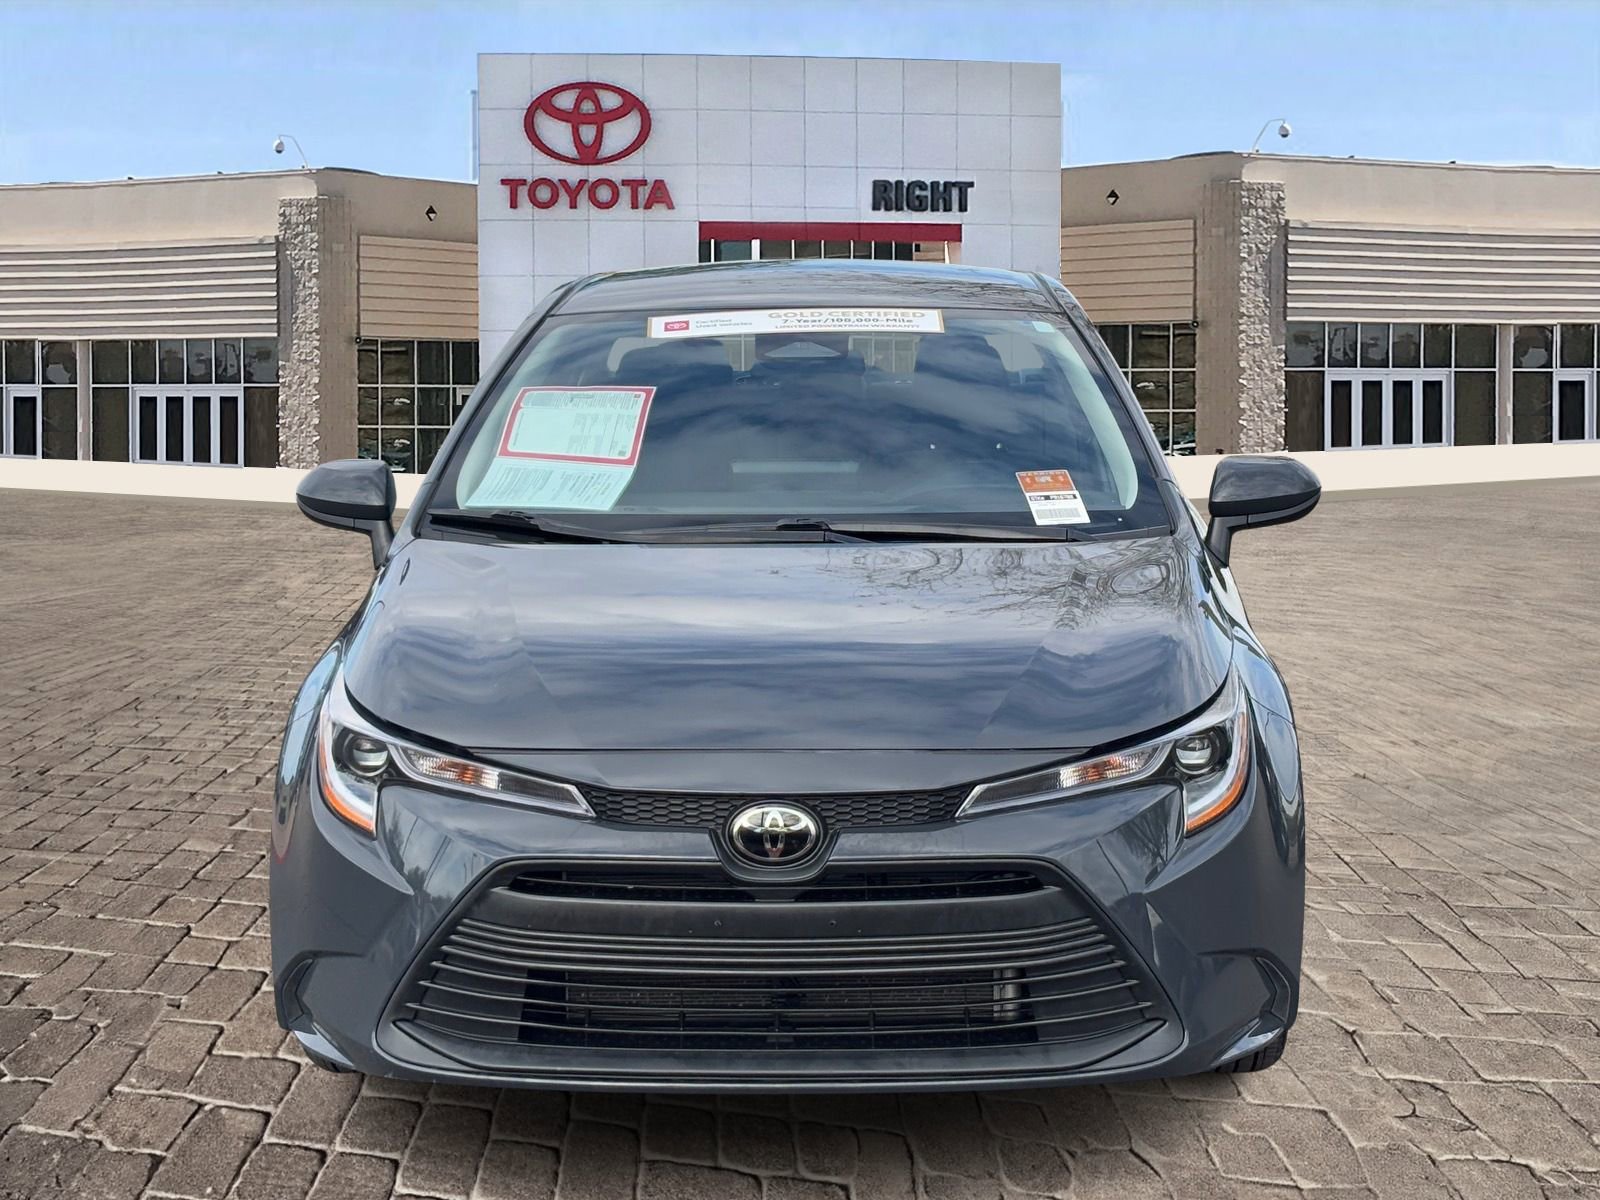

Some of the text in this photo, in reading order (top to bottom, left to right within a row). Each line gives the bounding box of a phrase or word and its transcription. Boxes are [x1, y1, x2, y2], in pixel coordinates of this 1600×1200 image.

[500, 178, 675, 209] TOYOTA
[872, 179, 975, 212] RIGHT
[768, 310, 925, 319] GOLD CERTIFIED
